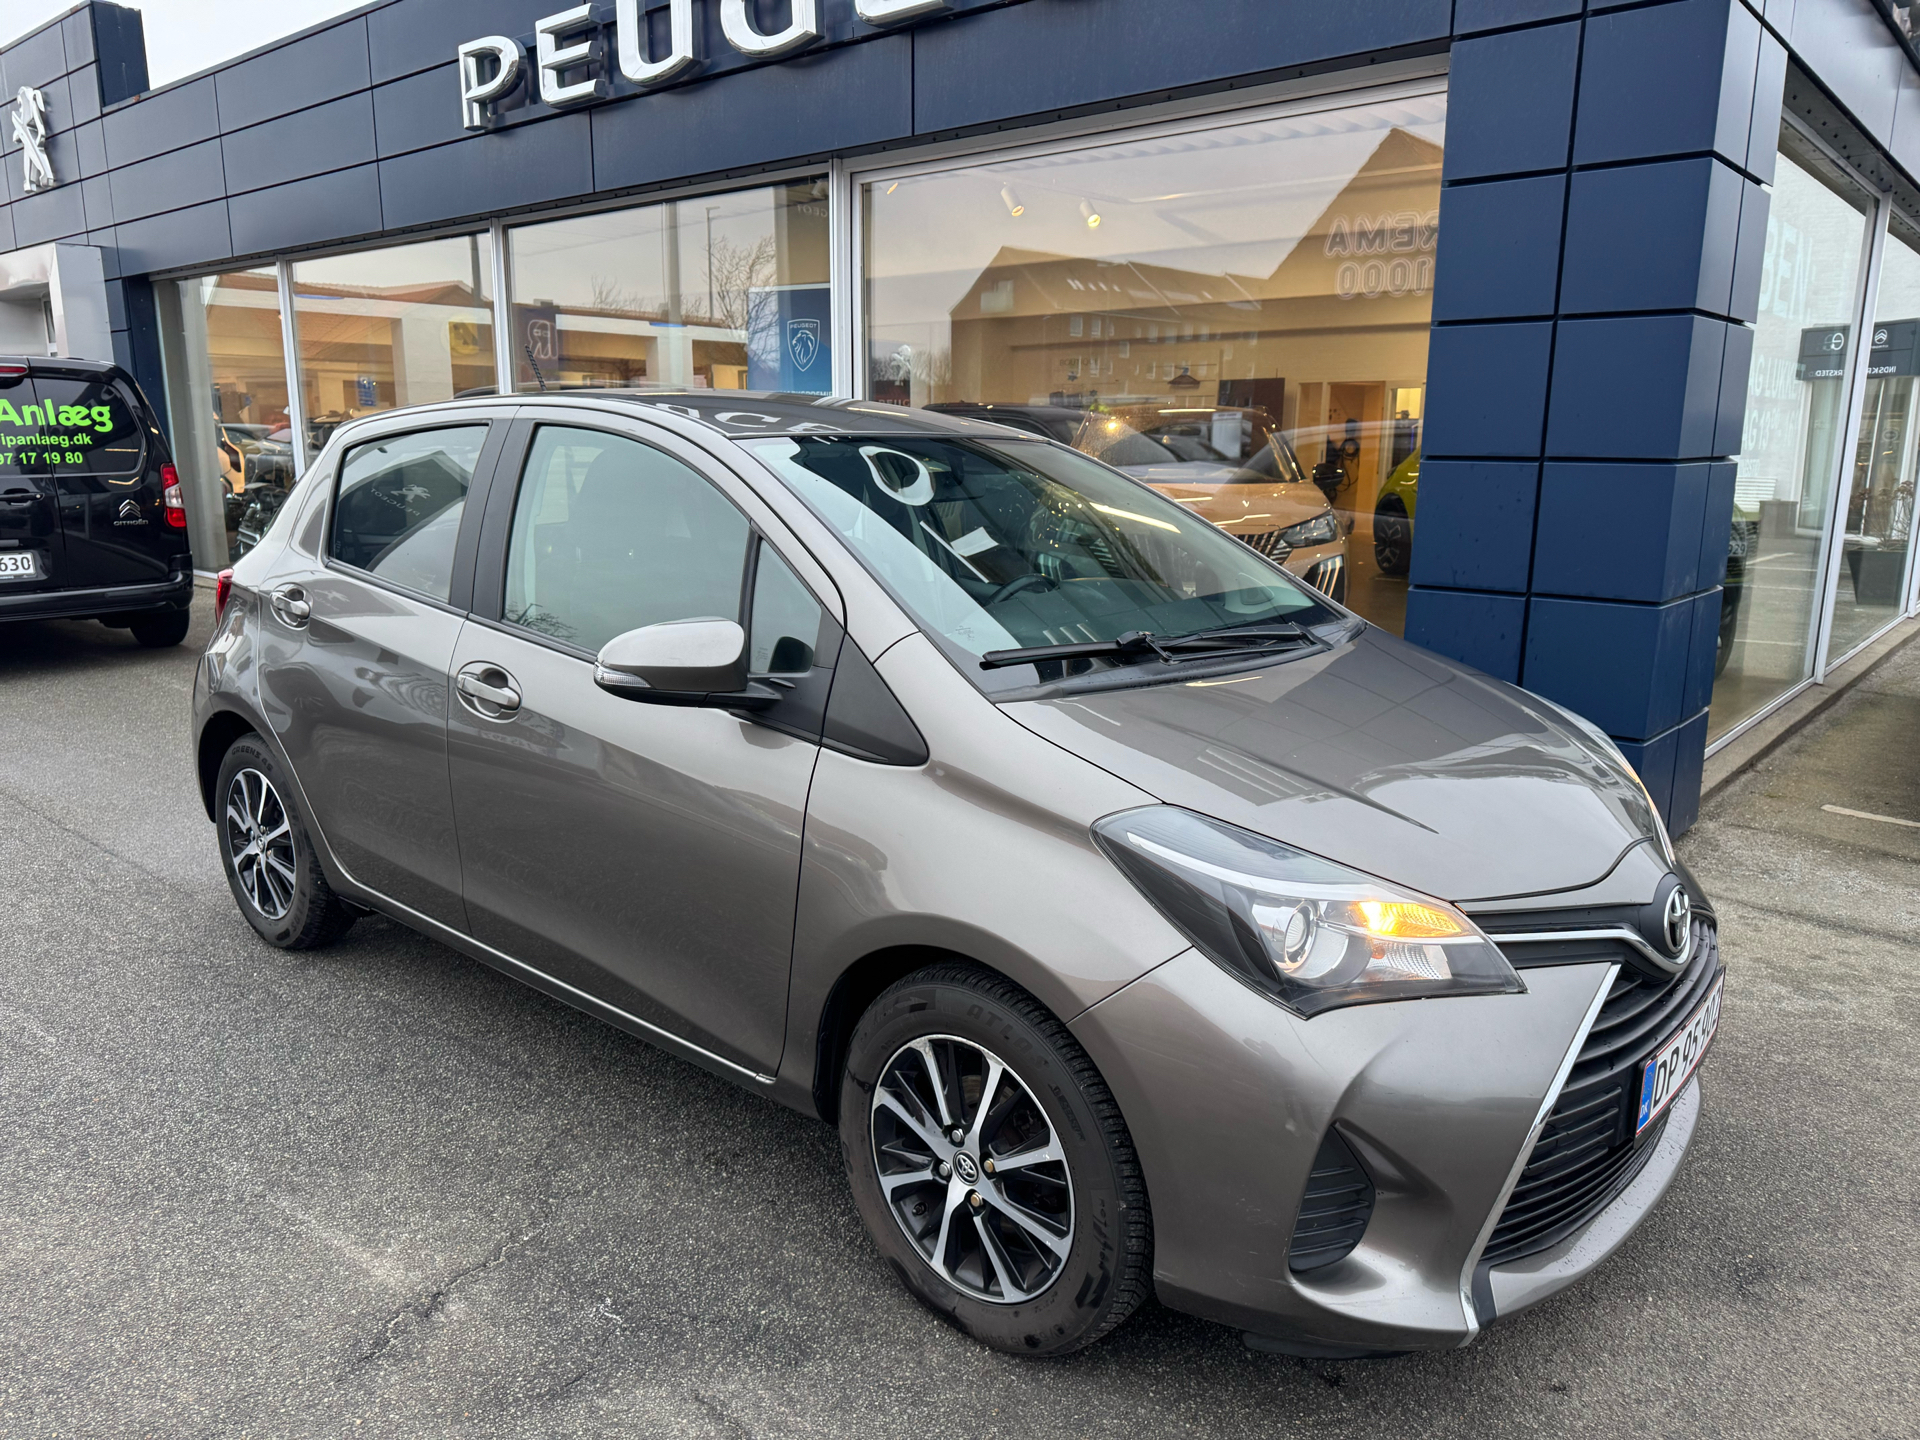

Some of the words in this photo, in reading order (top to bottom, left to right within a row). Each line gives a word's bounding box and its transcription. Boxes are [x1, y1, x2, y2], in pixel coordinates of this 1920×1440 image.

[457, 0, 956, 131] PEUG
[0, 398, 113, 432] Anlæg
[19, 452, 37, 465] 17
[42, 452, 61, 464] 19
[64, 451, 83, 464] 80
[0, 556, 31, 572] 630
[966, 1003, 1050, 1071] ATLAS
[1652, 1045, 1680, 1109] DP
[1681, 1016, 1702, 1077] 95
[1639, 1098, 1651, 1119] DK
